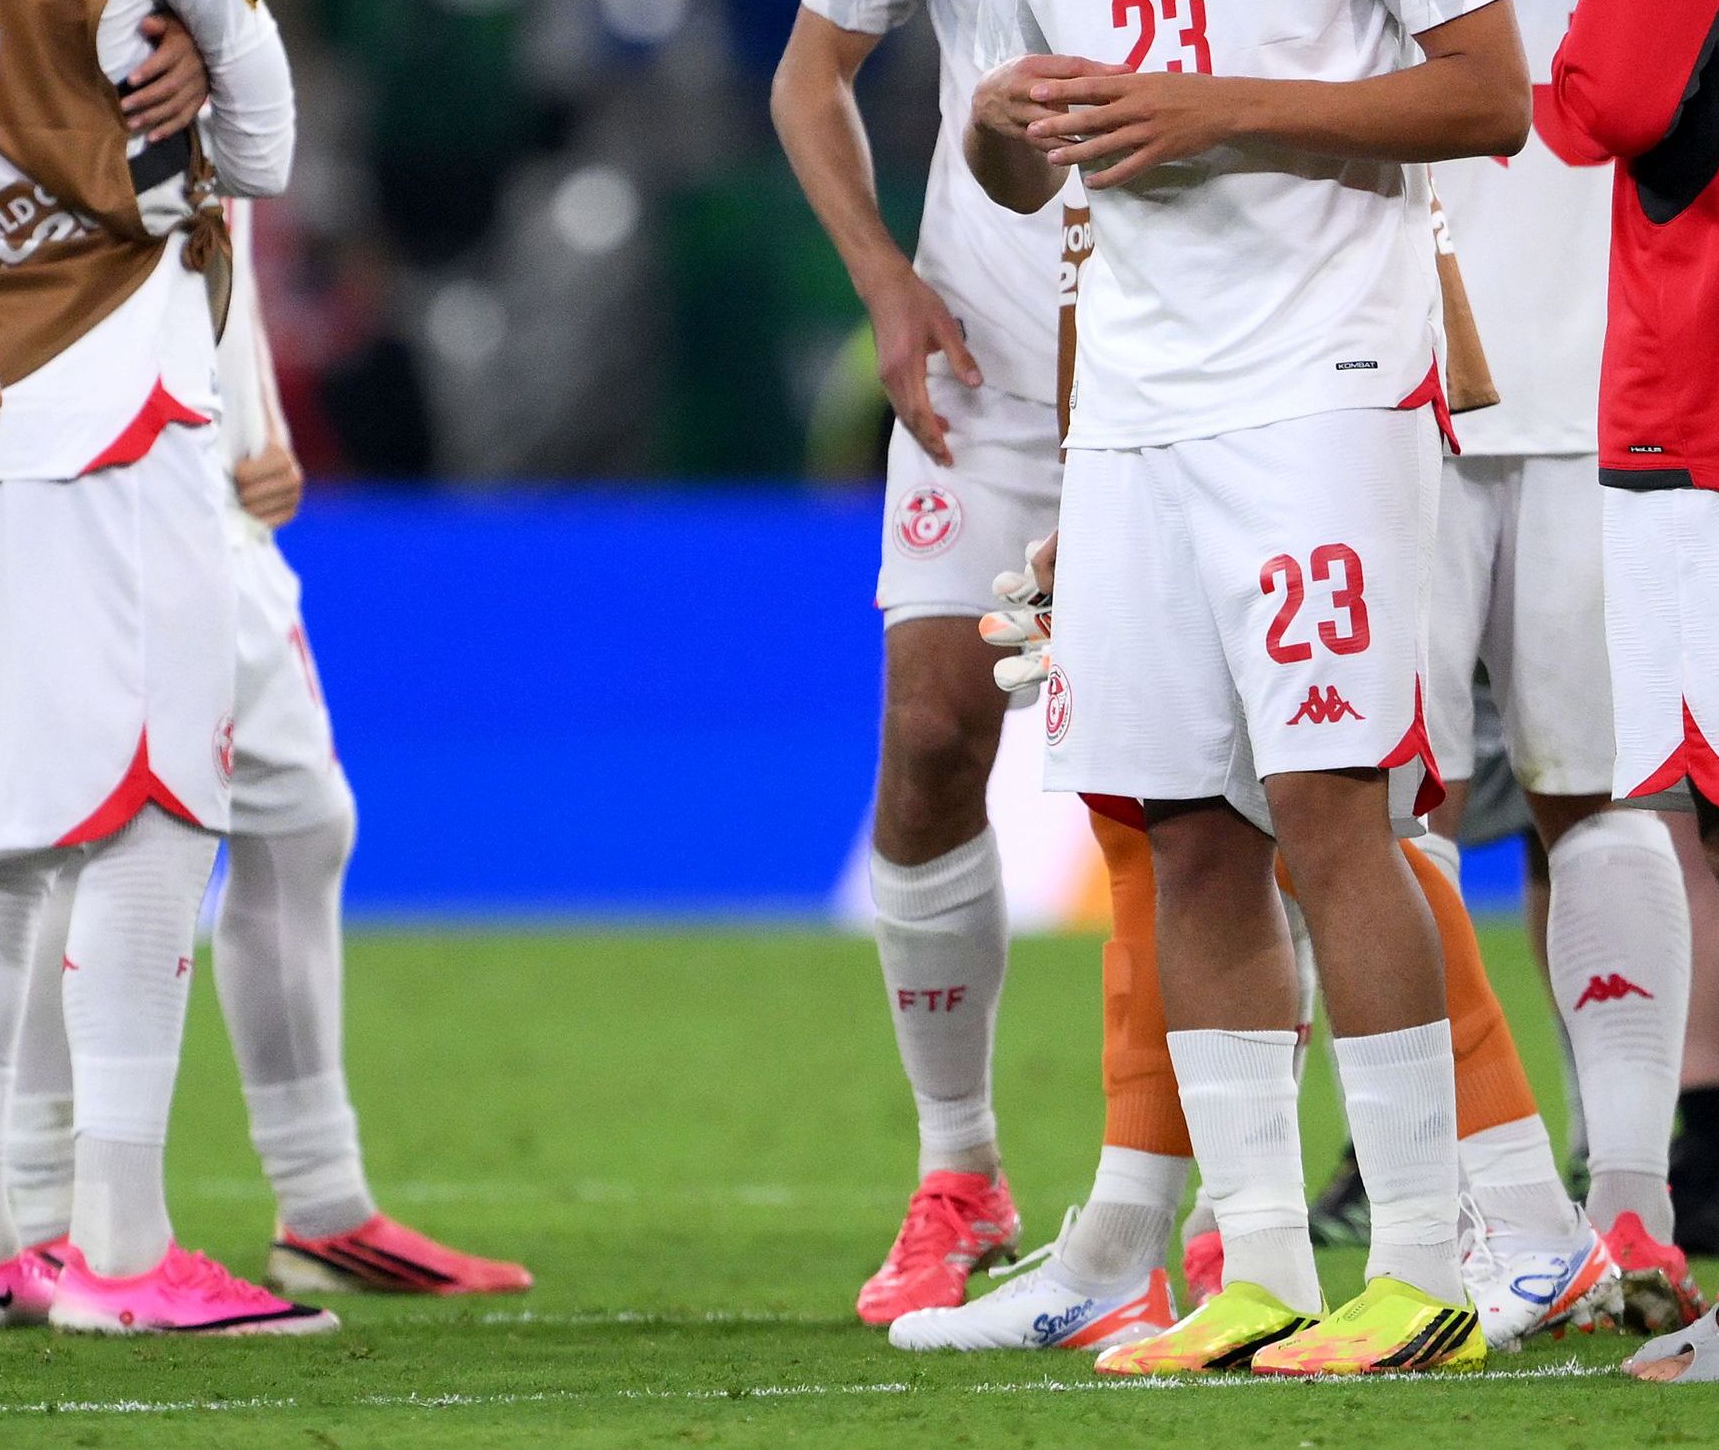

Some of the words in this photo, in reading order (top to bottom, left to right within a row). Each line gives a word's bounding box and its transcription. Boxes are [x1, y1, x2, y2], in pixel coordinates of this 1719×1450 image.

[1338, 362, 1376, 370] KOMBAT
[1259, 542, 1371, 665] 23
[897, 984, 968, 1012] FTF
